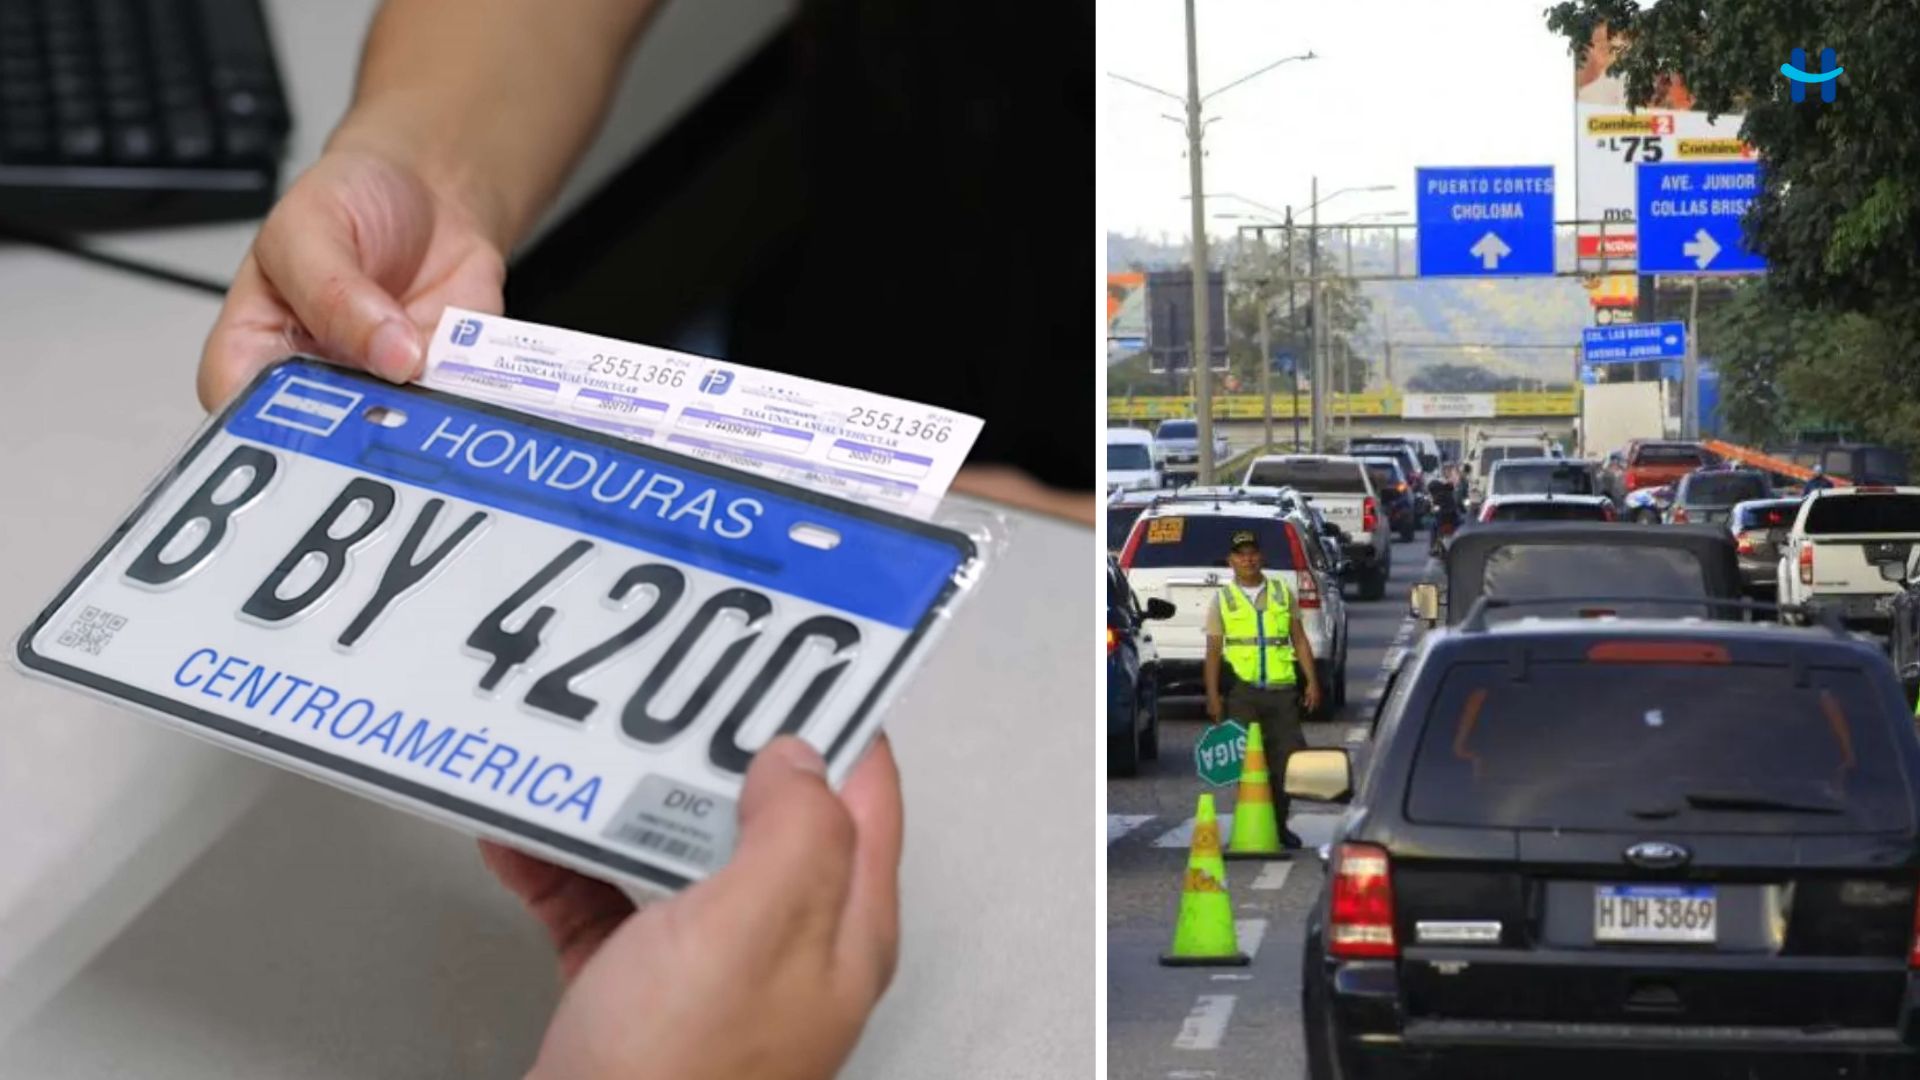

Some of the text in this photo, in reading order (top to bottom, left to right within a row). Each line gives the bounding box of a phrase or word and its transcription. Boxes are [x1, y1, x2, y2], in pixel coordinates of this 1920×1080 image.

[1589, 115, 1670, 134] Combina 2
[1427, 177, 1554, 195] PUERTO CORTES
[1661, 174, 1756, 191] AVE. JUNIOR
[1451, 202, 1524, 220] CHOLOMA
[584, 375, 639, 394] VEHICULAR
[587, 354, 687, 388] 2551366
[741, 407, 765, 420] TASA
[804, 420, 836, 435] ANUAL
[838, 428, 899, 447] VEHICULAR
[846, 406, 952, 444] 2551366
[421, 416, 764, 541] HONDURAS
[125, 445, 862, 775] B BY 4200
[173, 648, 603, 822] CENTROAMÉRICA
[1200, 736, 1246, 771] SIGA
[663, 789, 714, 817] DIC
[1654, 900, 1712, 930] 3869
